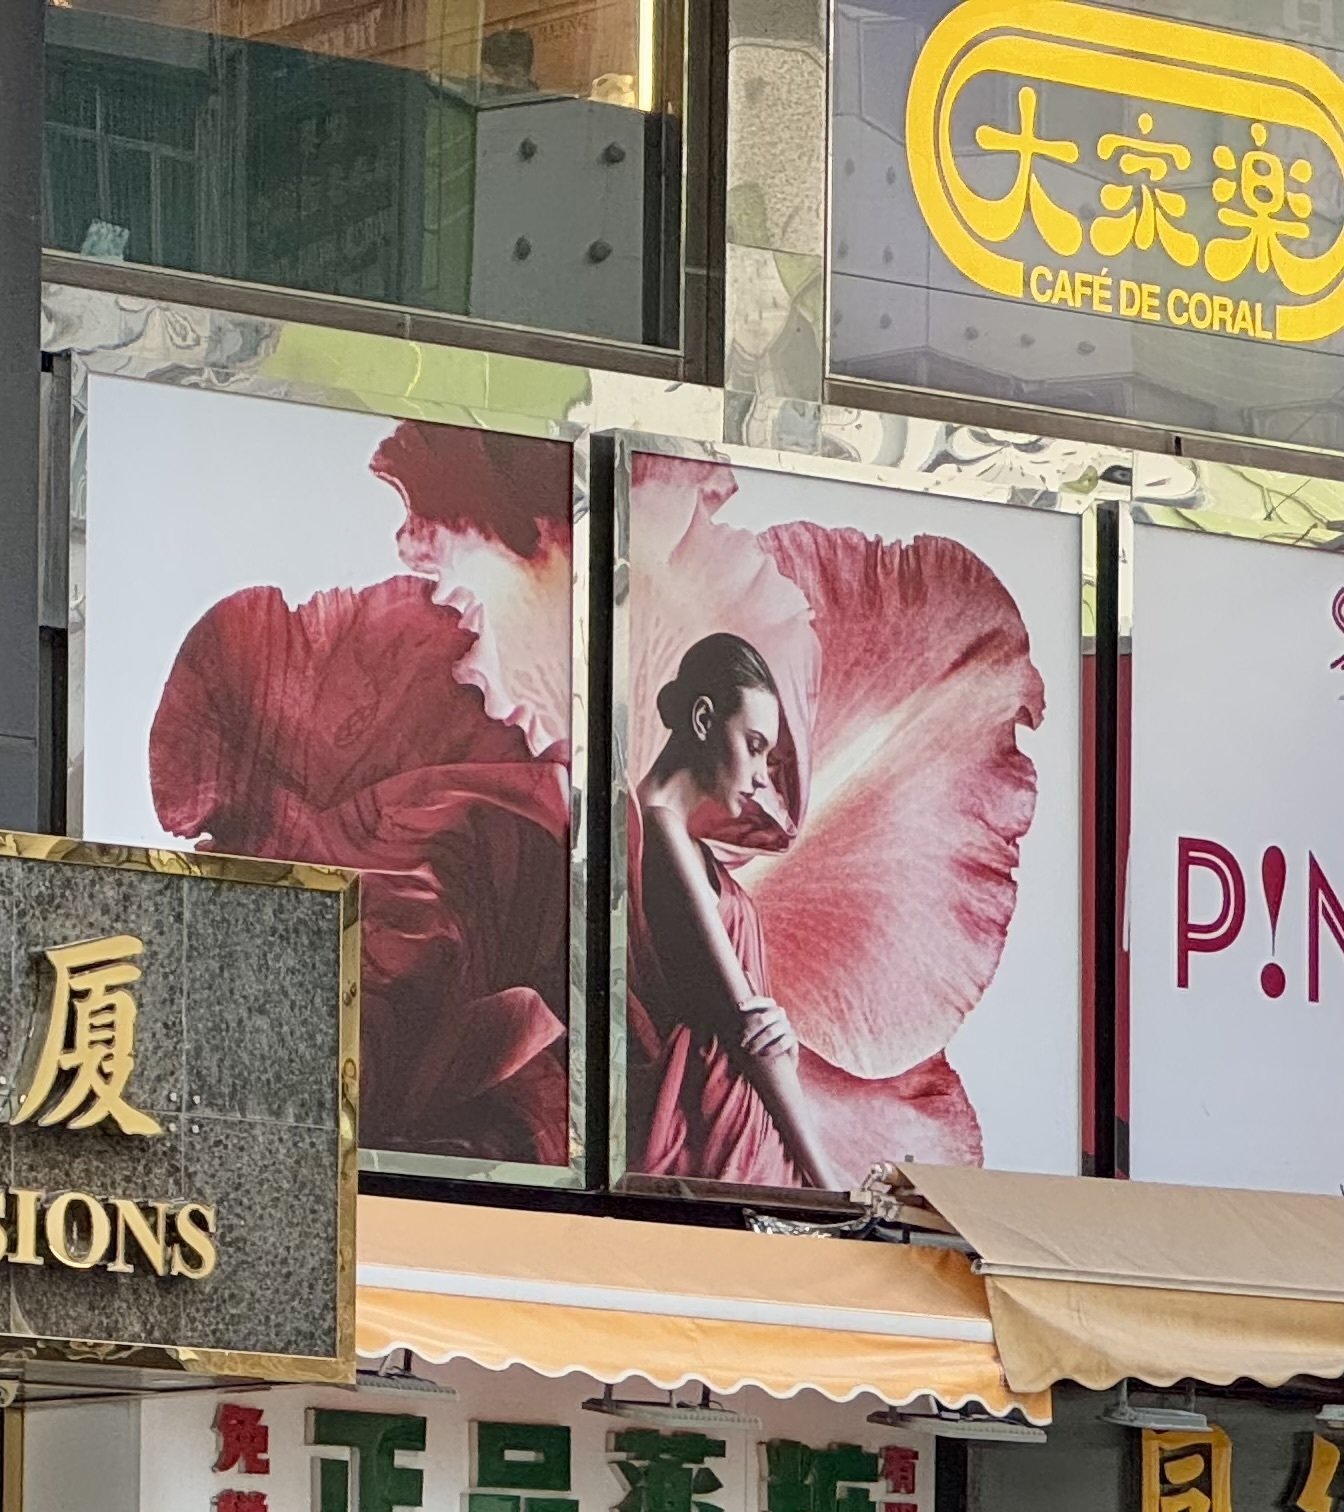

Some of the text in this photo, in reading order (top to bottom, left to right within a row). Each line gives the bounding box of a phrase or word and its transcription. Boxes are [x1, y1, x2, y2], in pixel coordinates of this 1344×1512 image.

[1028, 267, 1275, 340] CAFÉ DE CORAL
